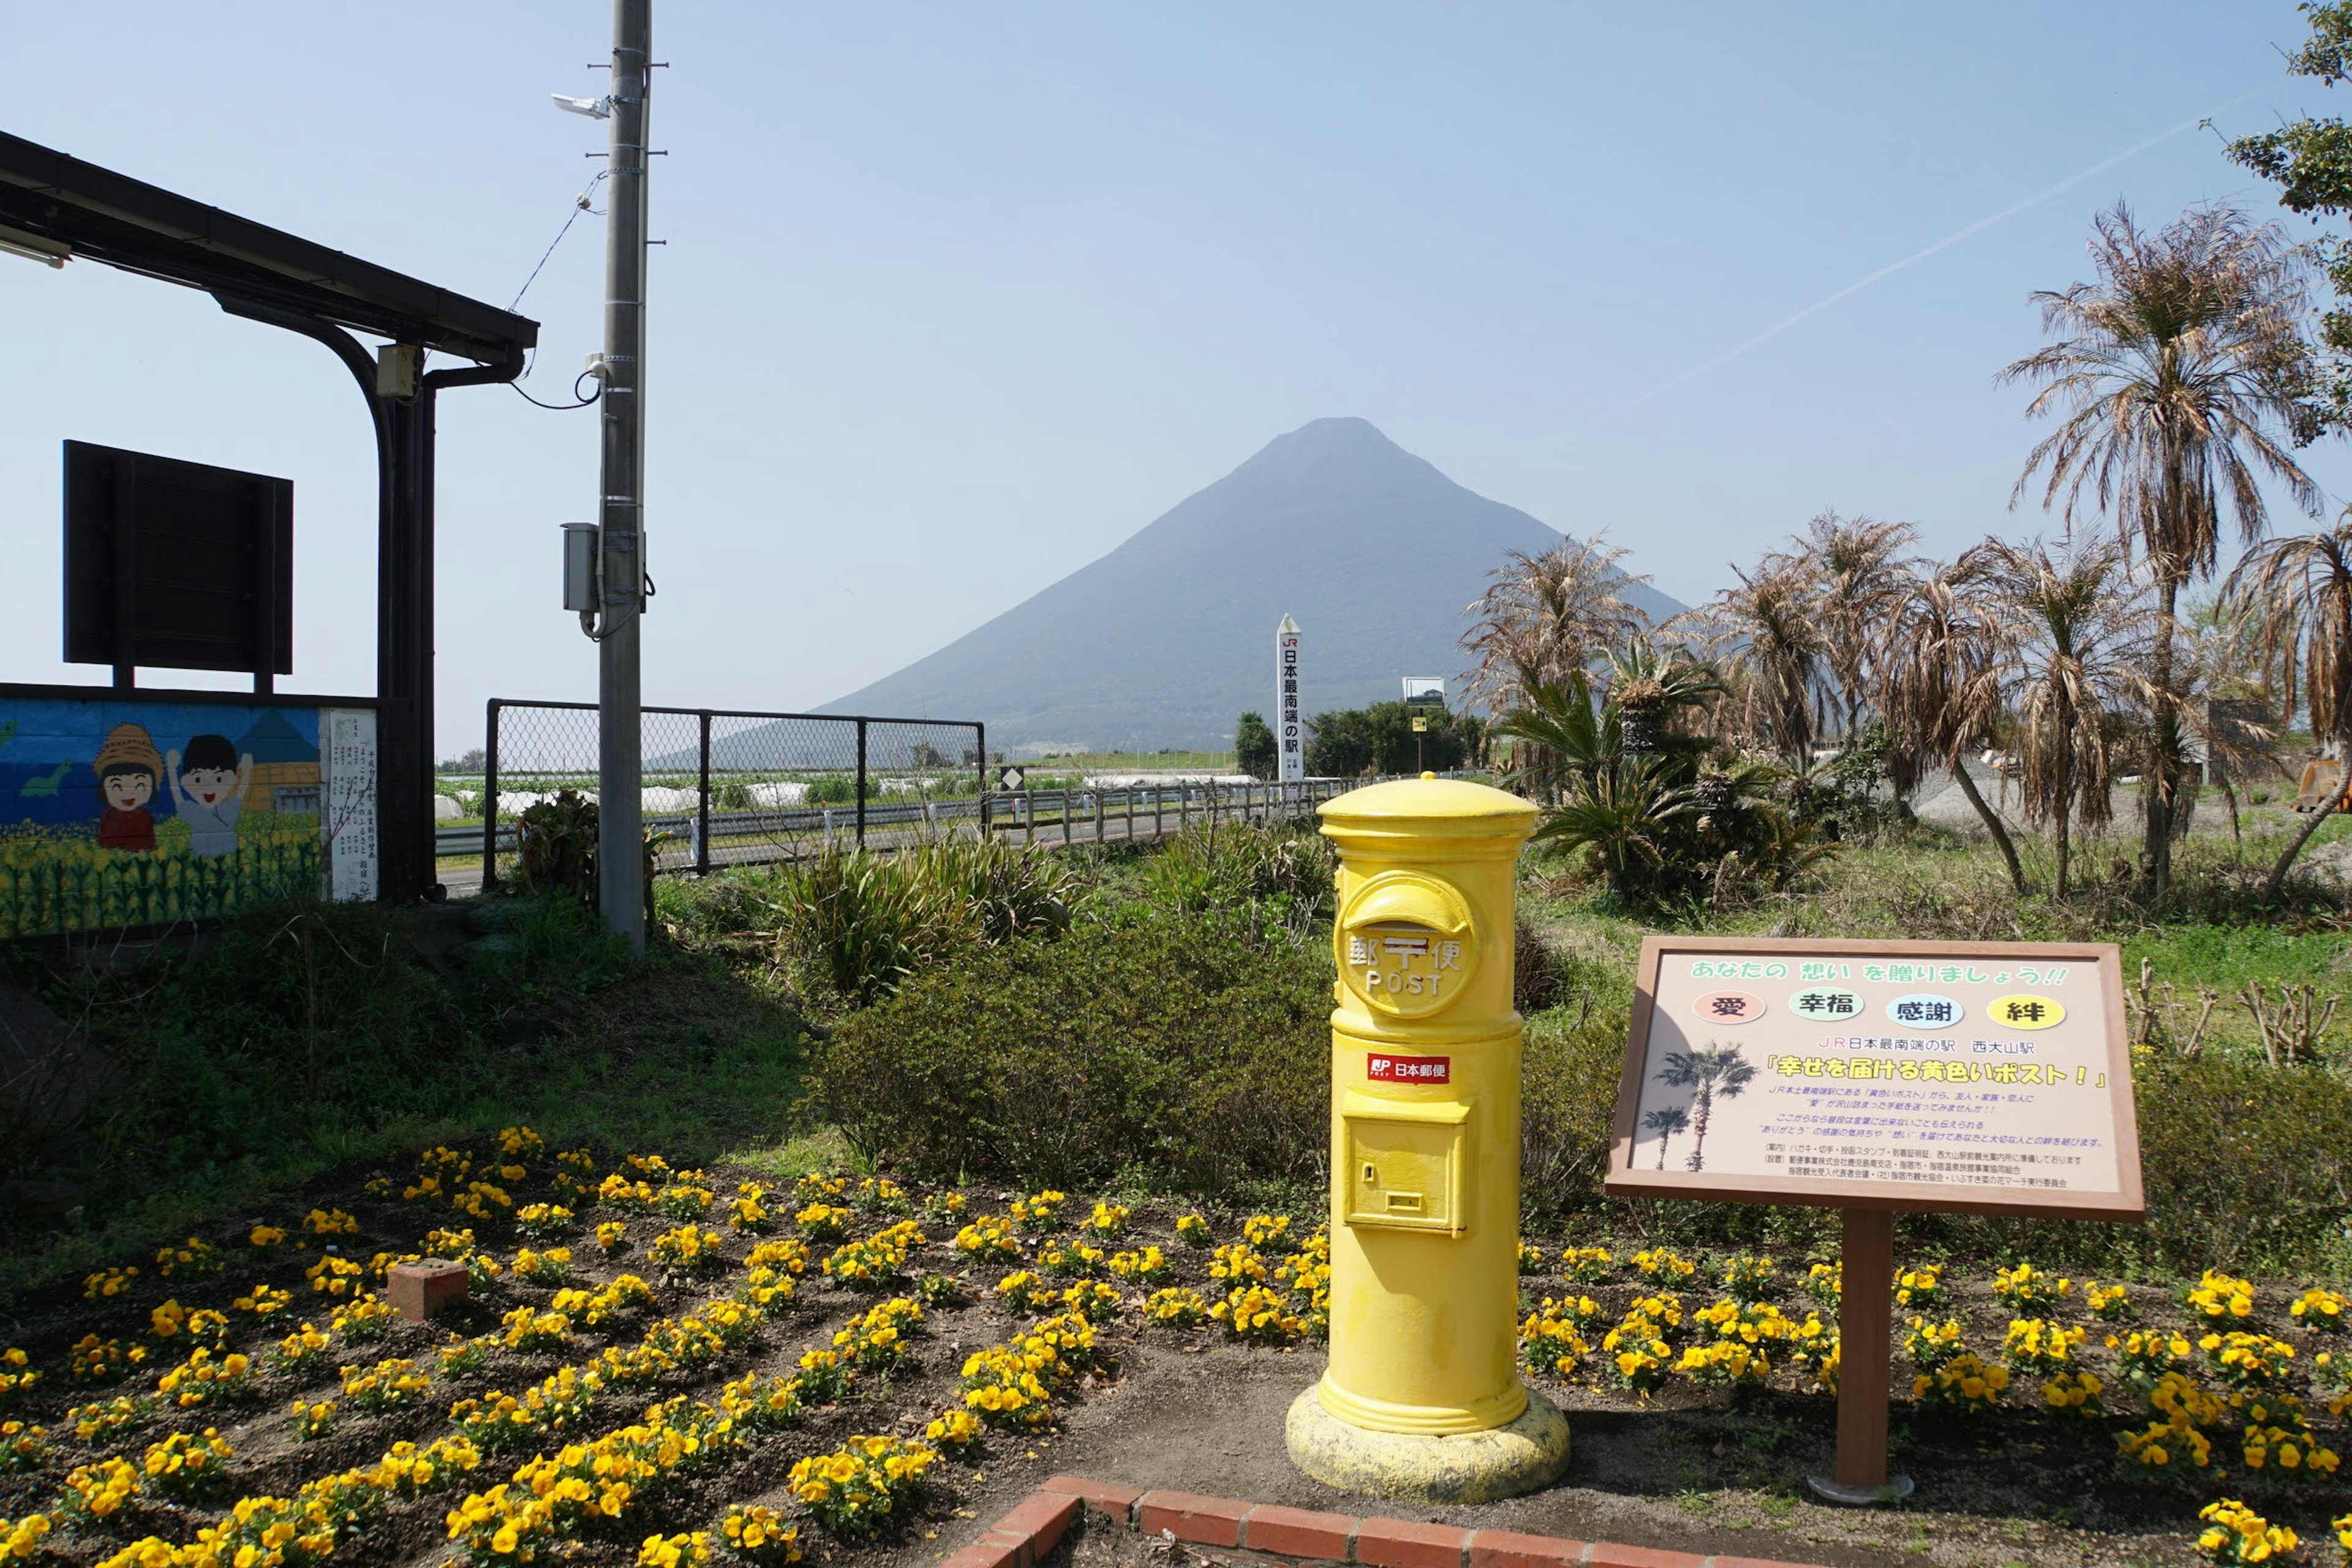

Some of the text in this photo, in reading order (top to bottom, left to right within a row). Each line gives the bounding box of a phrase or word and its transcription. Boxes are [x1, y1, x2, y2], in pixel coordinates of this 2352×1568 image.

[1366, 970, 1442, 996] POST
[1692, 960, 2069, 985] あなたの 想い を贈りましょう!!
[1712, 993, 2045, 1022] 愛 幸福 感謝 絆
[1972, 1040, 2035, 1054] 西大山駅
[1395, 1063, 1446, 1077] 日本郵便
